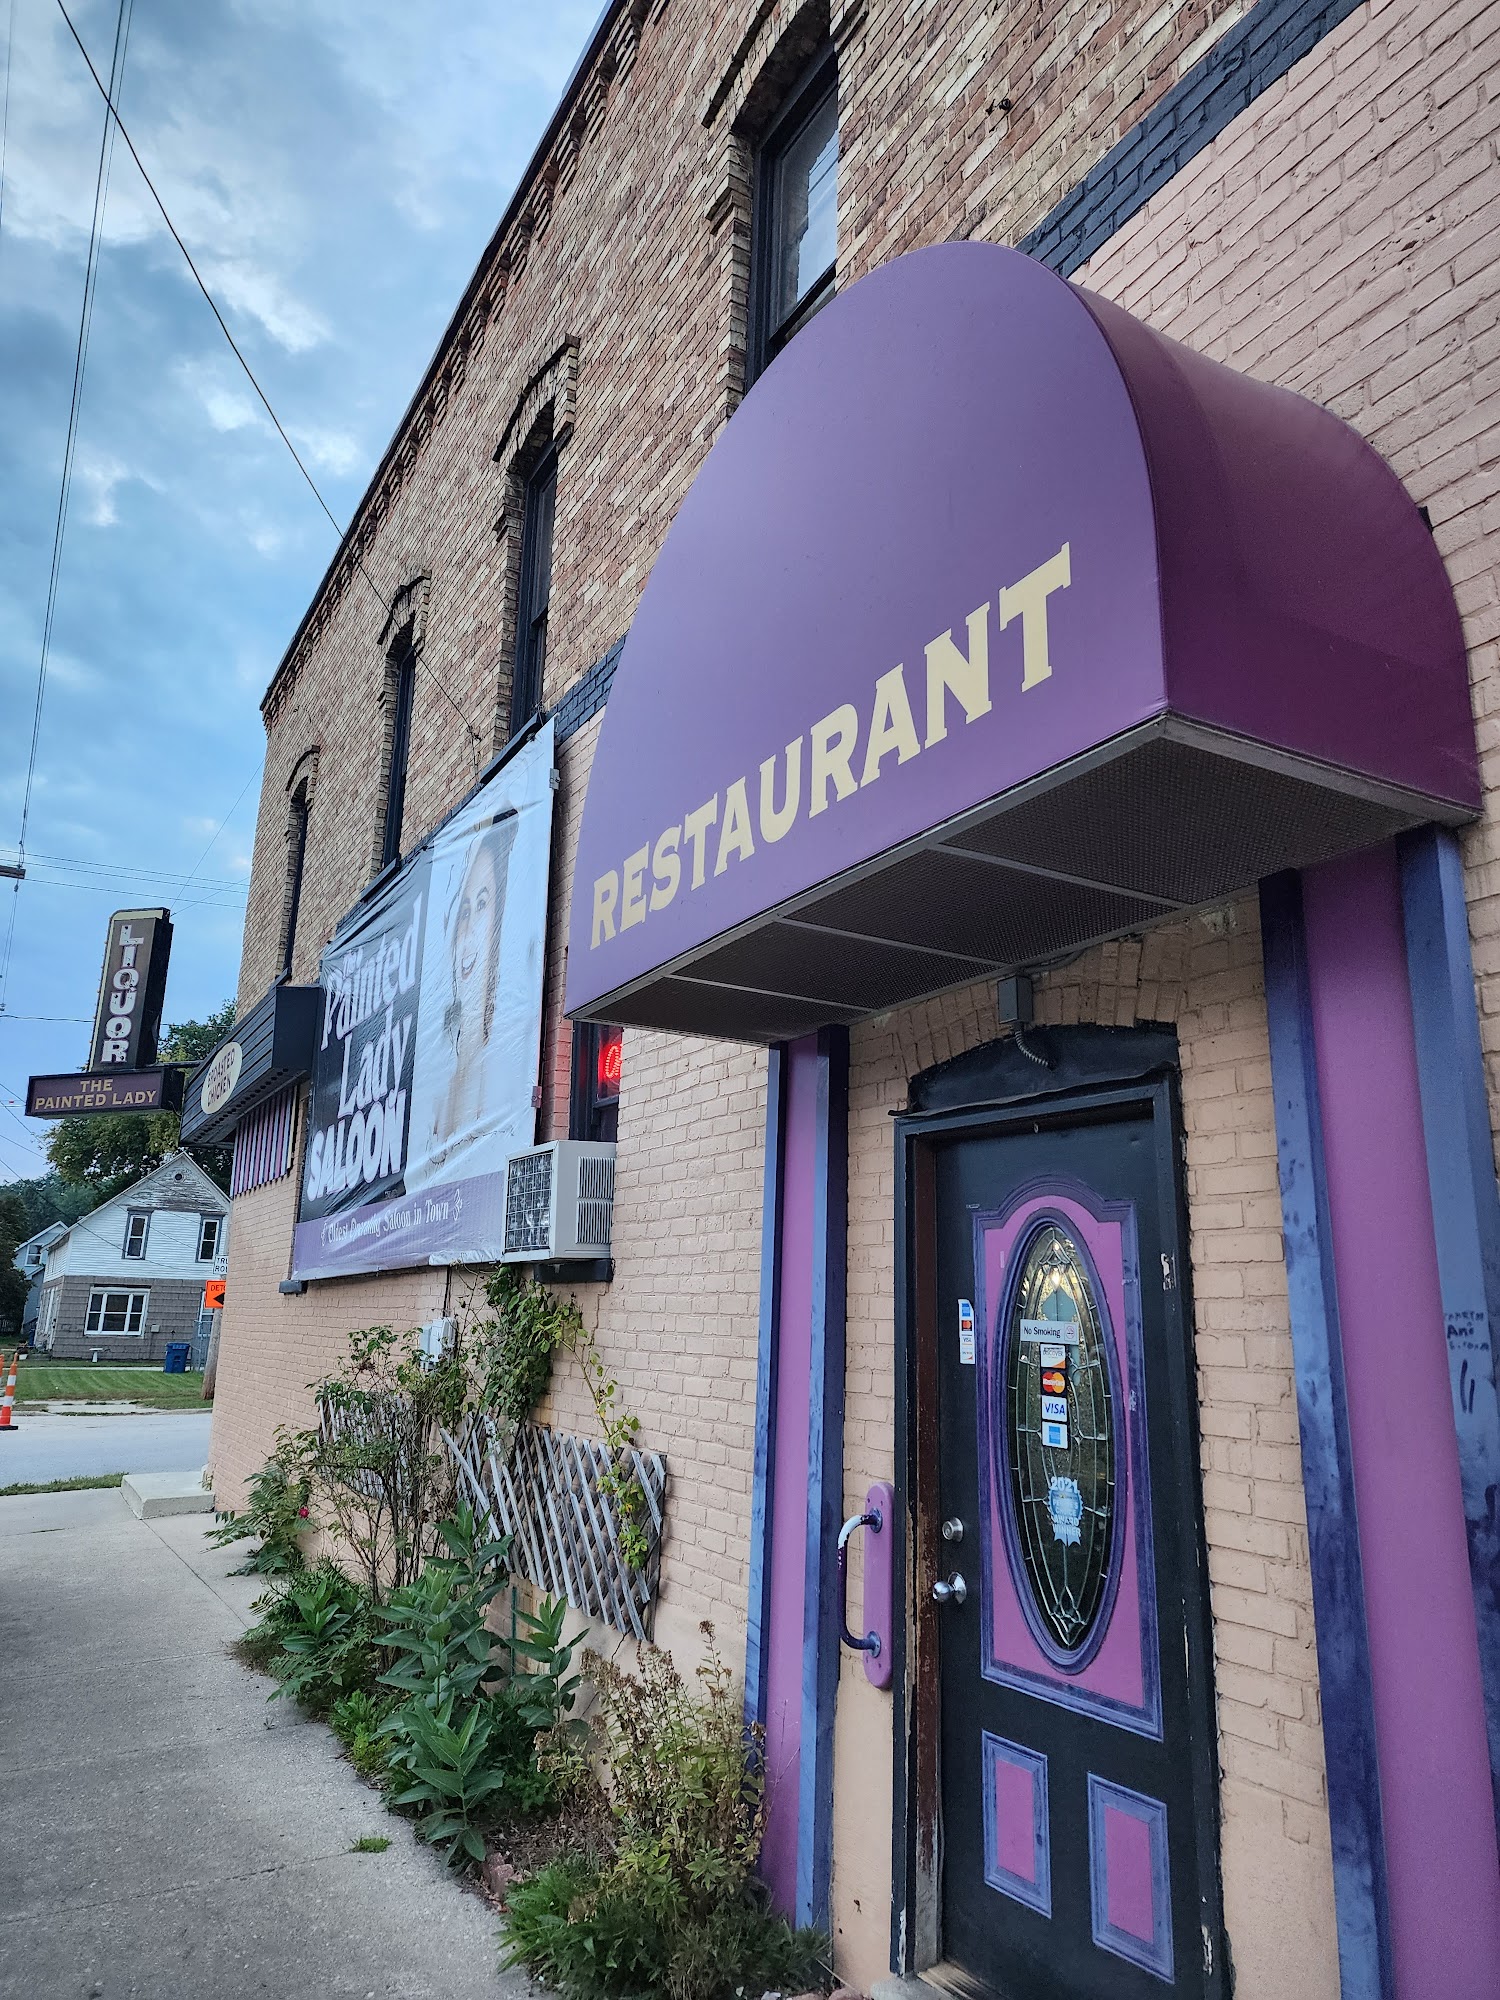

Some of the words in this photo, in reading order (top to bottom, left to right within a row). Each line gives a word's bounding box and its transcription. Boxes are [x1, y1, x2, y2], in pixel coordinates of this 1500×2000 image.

[590, 542, 1072, 951] RESTAURANT
[320, 890, 423, 1052] Painted
[100, 924, 144, 1062] LIQUOR
[337, 1001, 413, 1119] Lady
[80, 1078, 114, 1093] THE
[207, 1071, 232, 1107] CHICKEN
[34, 1094, 107, 1111] PAINTED
[112, 1090, 157, 1106] LADY
[306, 1089, 407, 1202] SALOON
[383, 1206, 411, 1232] Saloon
[413, 1201, 422, 1226] in
[425, 1198, 449, 1224] Town
[1023, 1326, 1032, 1335] No
[1033, 1326, 1061, 1339] Smoking
[1045, 1403, 1066, 1415] VISA
[1050, 1476, 1079, 1494] 2021
[1053, 1514, 1080, 1527] AWARD
[1053, 1524, 1082, 1537] WINNER
